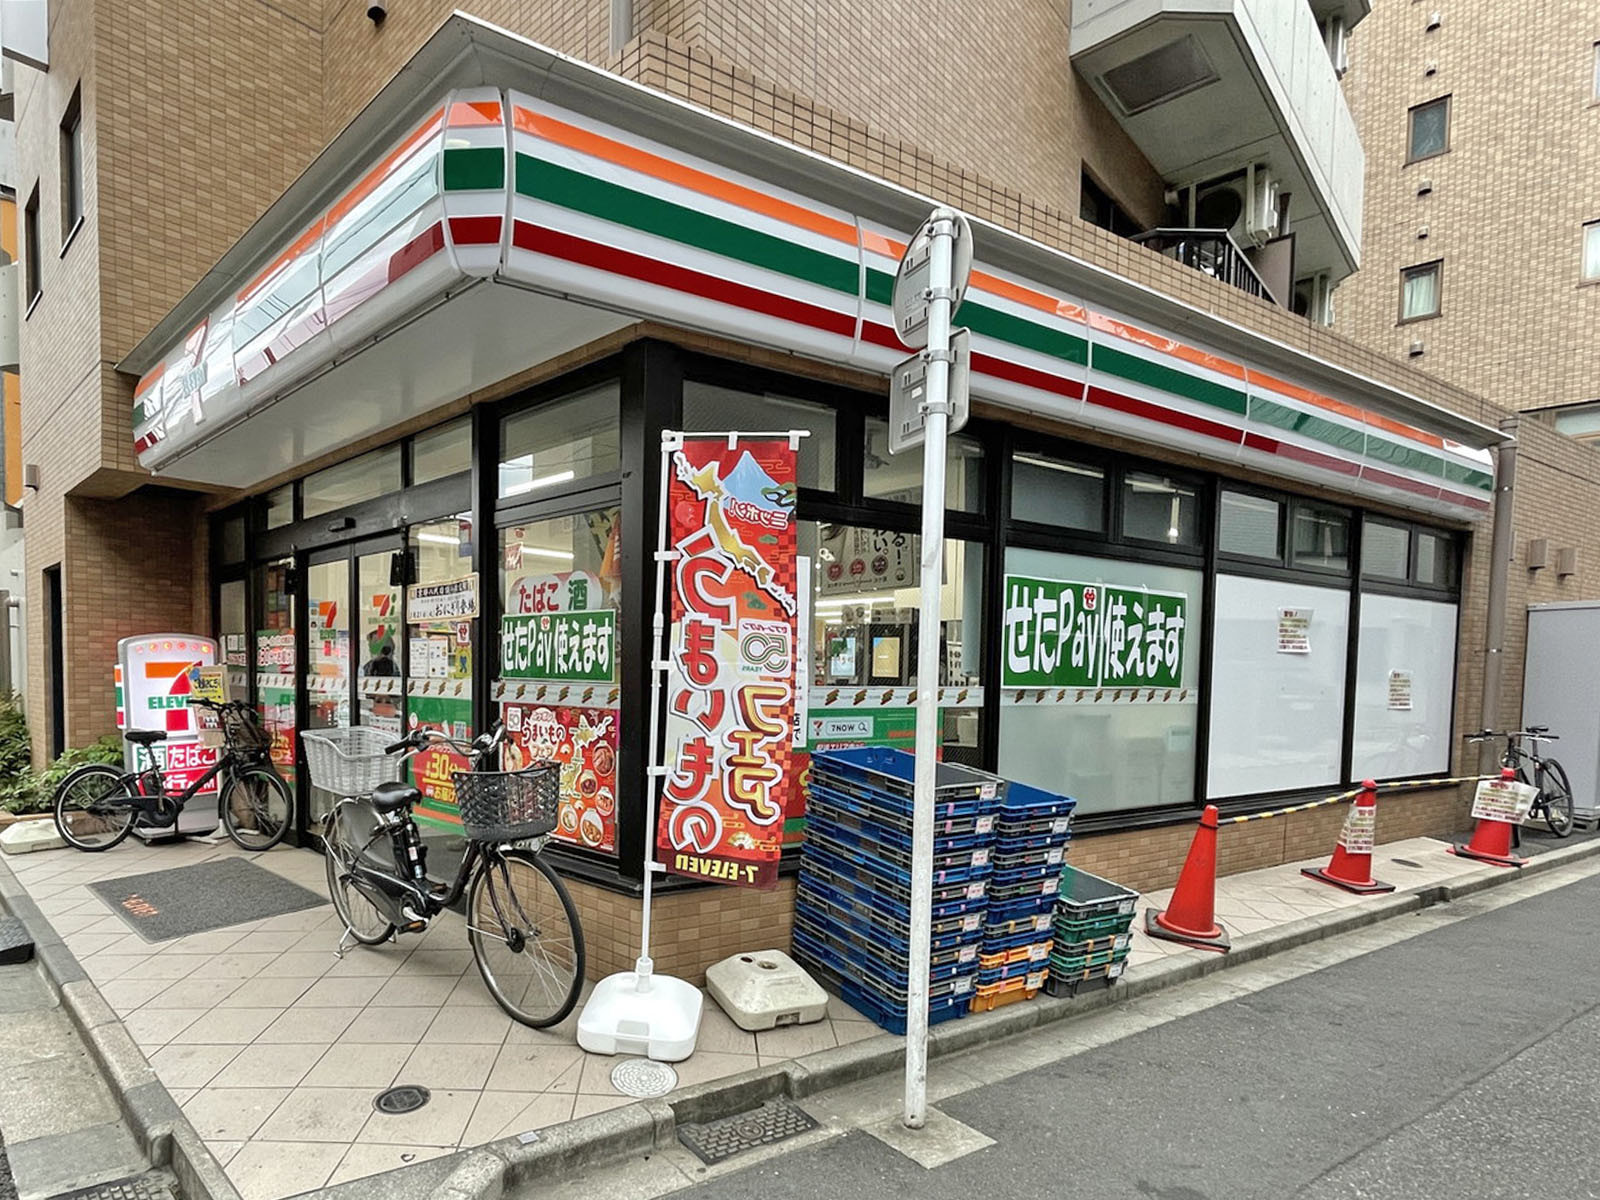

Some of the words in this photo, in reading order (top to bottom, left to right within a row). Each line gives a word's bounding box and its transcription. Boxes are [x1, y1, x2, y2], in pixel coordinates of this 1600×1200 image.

[519, 581, 560, 614] たばこ
[568, 579, 588, 612] 酒
[502, 617, 612, 675] せたPay使えます
[1005, 584, 1185, 680] せたPay使えます
[523, 720, 566, 745] うまいもの
[831, 724, 855, 732] 7NOW
[168, 744, 216, 769] たばこ
